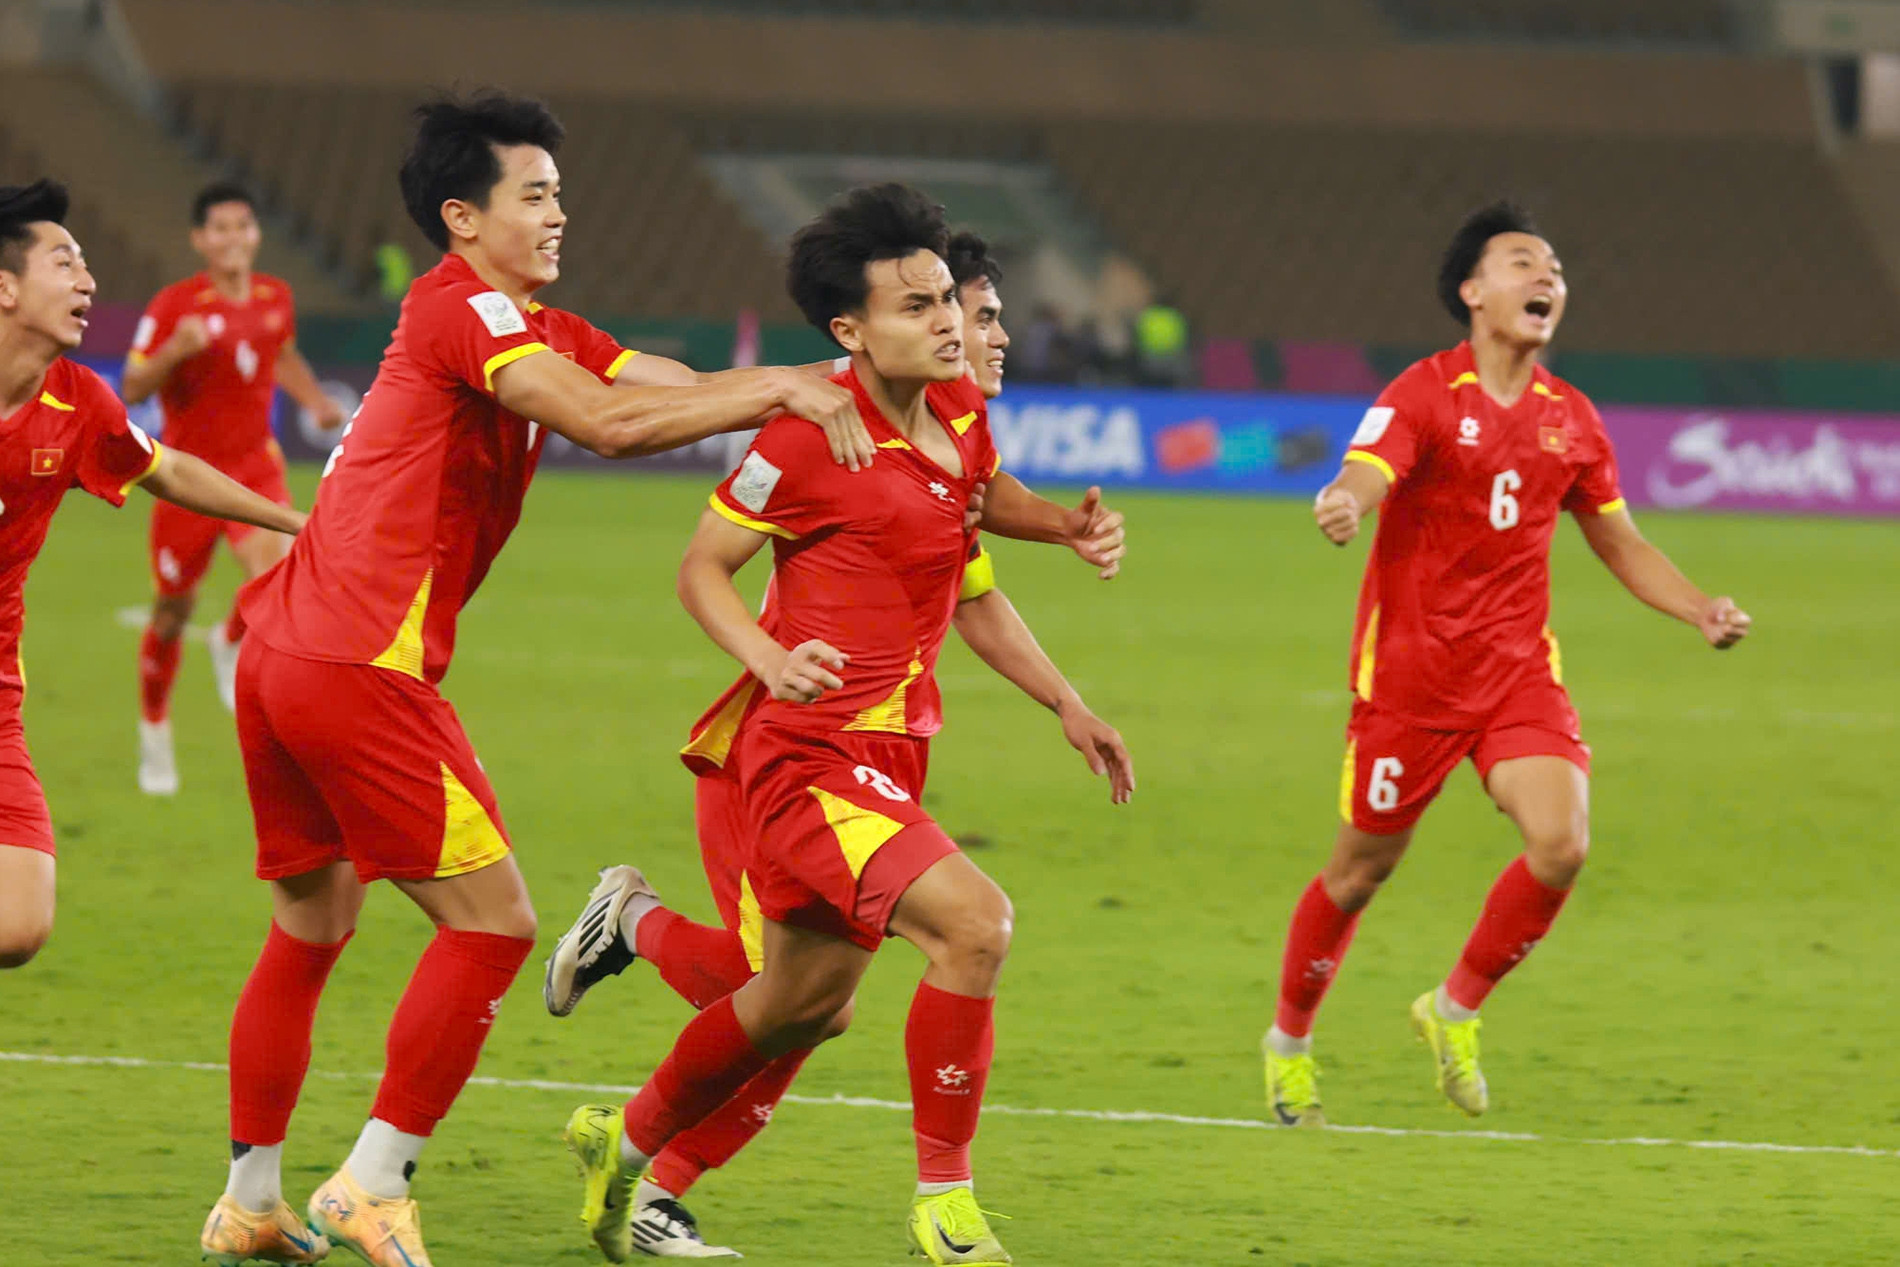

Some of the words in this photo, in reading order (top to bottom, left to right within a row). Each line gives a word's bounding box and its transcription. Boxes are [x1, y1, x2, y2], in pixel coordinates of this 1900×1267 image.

[990, 402, 1146, 477] VISA
[1489, 469, 1522, 531] 6
[1367, 757, 1404, 811] 6
